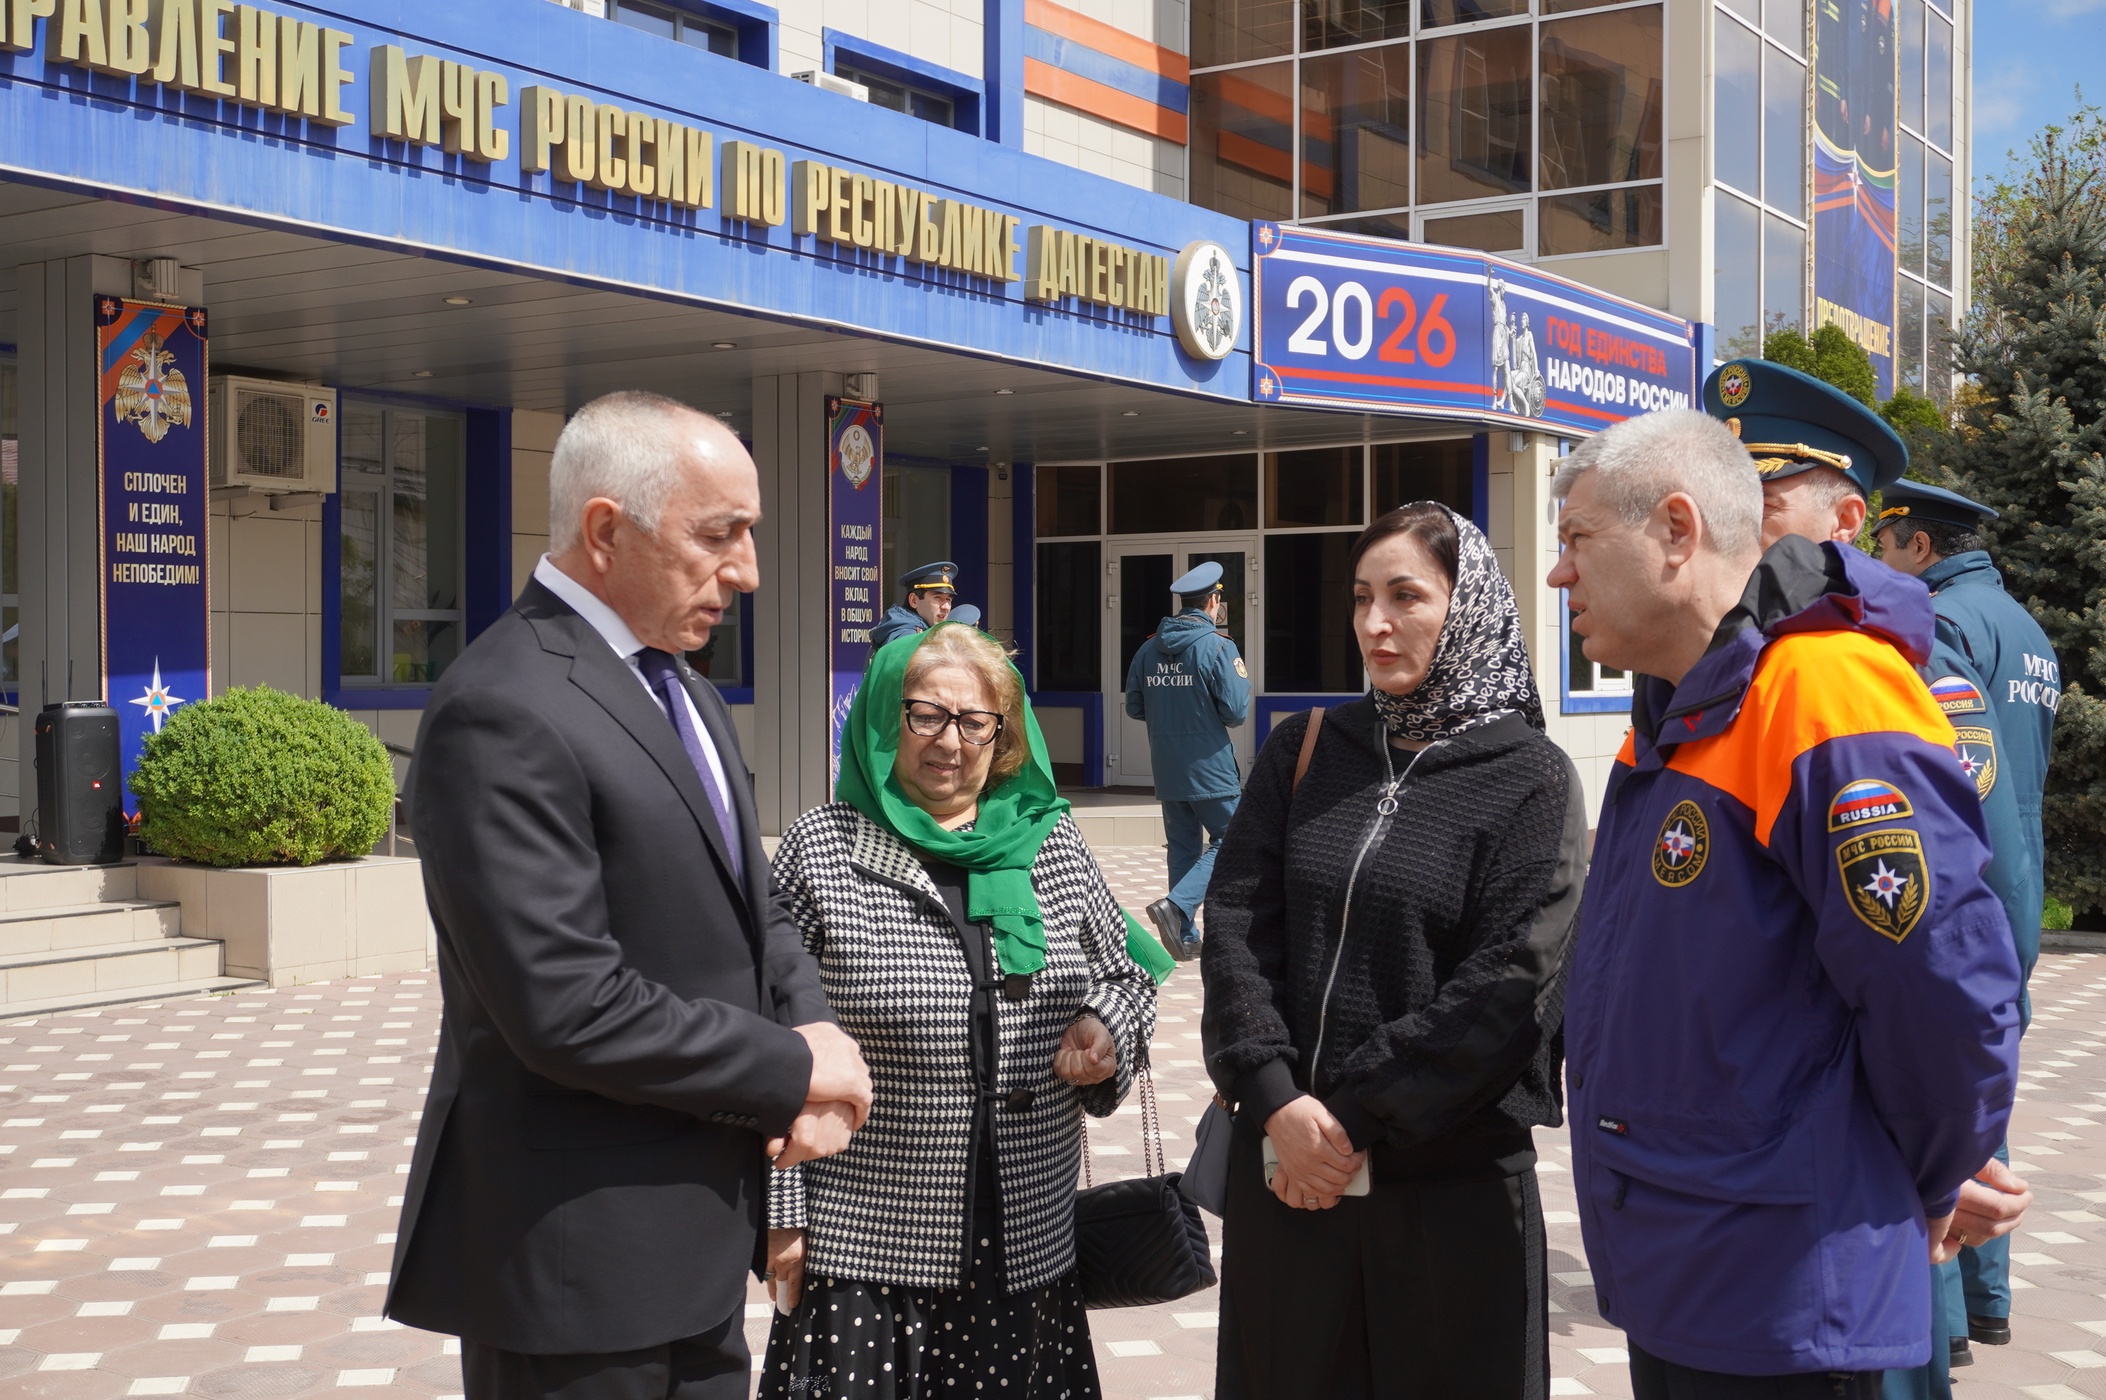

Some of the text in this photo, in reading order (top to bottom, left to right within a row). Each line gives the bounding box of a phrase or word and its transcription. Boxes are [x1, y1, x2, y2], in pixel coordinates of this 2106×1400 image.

[371, 45, 509, 163] МЧС
[521, 85, 712, 209] РОССИИ
[722, 140, 785, 227] ПО
[792, 160, 1021, 282] РЕСПУБЛИКЕ
[1026, 225, 1169, 317] ДАГЕСТАН
[1286, 276, 1457, 368] 2026
[1547, 315, 1668, 377] ГОД ЕДИНСТВА
[1547, 357, 1626, 404] НАРОДОВ
[1628, 378, 1689, 412] РОССИИ
[124, 472, 187, 494] СПЛОЧЕН
[129, 503, 183, 526] И ЕДИН,
[841, 524, 872, 540] КАЖДЫЙ
[116, 532, 196, 556] НАШ НАРОД
[845, 545, 868, 562] НАРОД
[113, 563, 200, 585] НЕПОБЕДИМ!
[834, 566, 878, 581] ВНОСИТ СВОЙ
[845, 587, 869, 603] ВКЛАД
[841, 608, 872, 623] В ОБЩУЮ
[1157, 662, 1184, 674] МЧС
[2023, 653, 2058, 684] МЧС
[1146, 675, 1193, 687] РОССИИ
[1956, 731, 1992, 743] РОССИИ
[1680, 804, 1706, 840] РОССИИ
[1840, 803, 1897, 823] RUSSIA
[1842, 835, 1914, 860] МЧС РОССИИ
